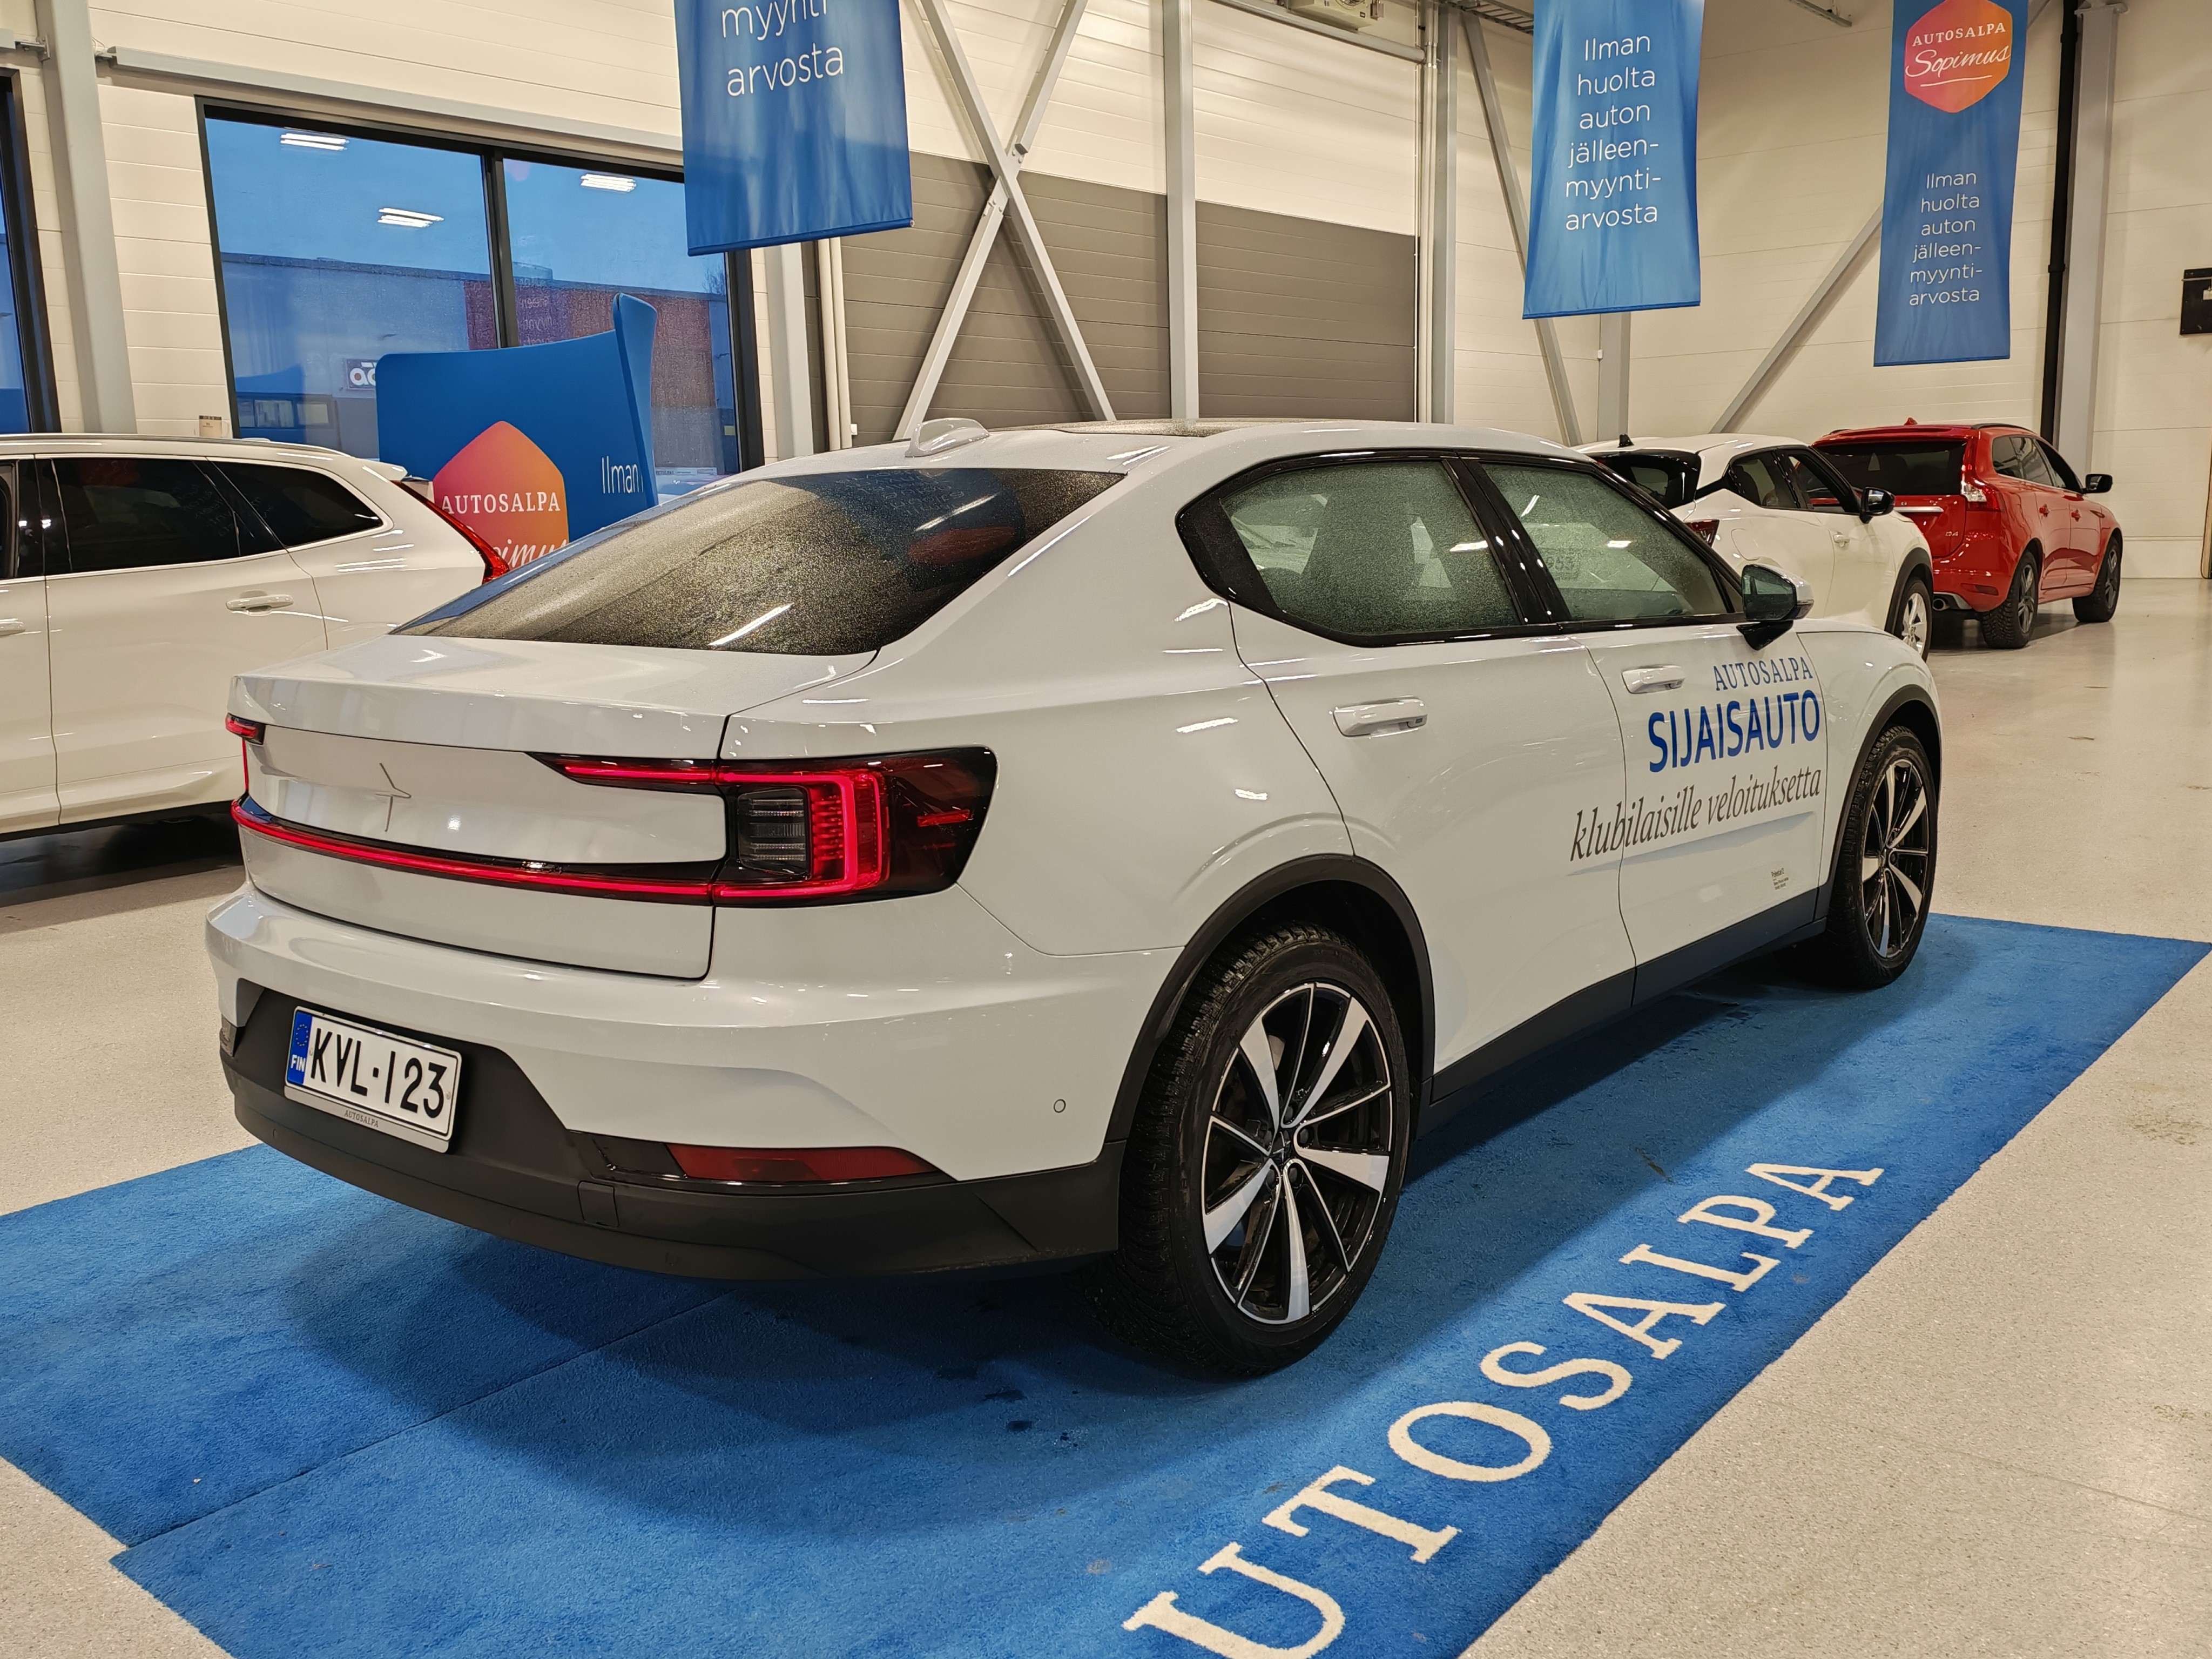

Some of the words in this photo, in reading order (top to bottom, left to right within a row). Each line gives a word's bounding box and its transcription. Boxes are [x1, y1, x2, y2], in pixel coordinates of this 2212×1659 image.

[1912, 22, 2006, 46] AUTOSALPA
[1585, 35, 1650, 61] Ilman
[1905, 45, 2011, 77] Sopimus
[727, 43, 843, 96] arvosta
[1577, 66, 1656, 96] huolta
[1580, 104, 1650, 130] auton
[1568, 137, 1659, 168] jälleen-
[1566, 167, 1661, 200] myynti-
[1926, 172, 1977, 189] Ilman
[1921, 193, 1980, 213] huolta
[1566, 203, 1658, 231] arvosta
[1921, 219, 1975, 236] auton
[1912, 242, 1981, 264] jälleen-
[1910, 263, 1982, 285] myynti-
[1909, 287, 1979, 306] arvosta
[602, 455, 639, 494] Ilman
[441, 491, 561, 515] AUTOSALPA
[1713, 656, 1813, 691] AUTOSALPA
[1648, 690, 1820, 773] SIJAISAUTO
[1570, 784, 1702, 862] klubilaisille
[1708, 765, 1822, 826] veloituksetta
[290, 1054, 306, 1073] FIN
[311, 1027, 448, 1118] KVL-123
[345, 1110, 378, 1128] AUTOSALPA
